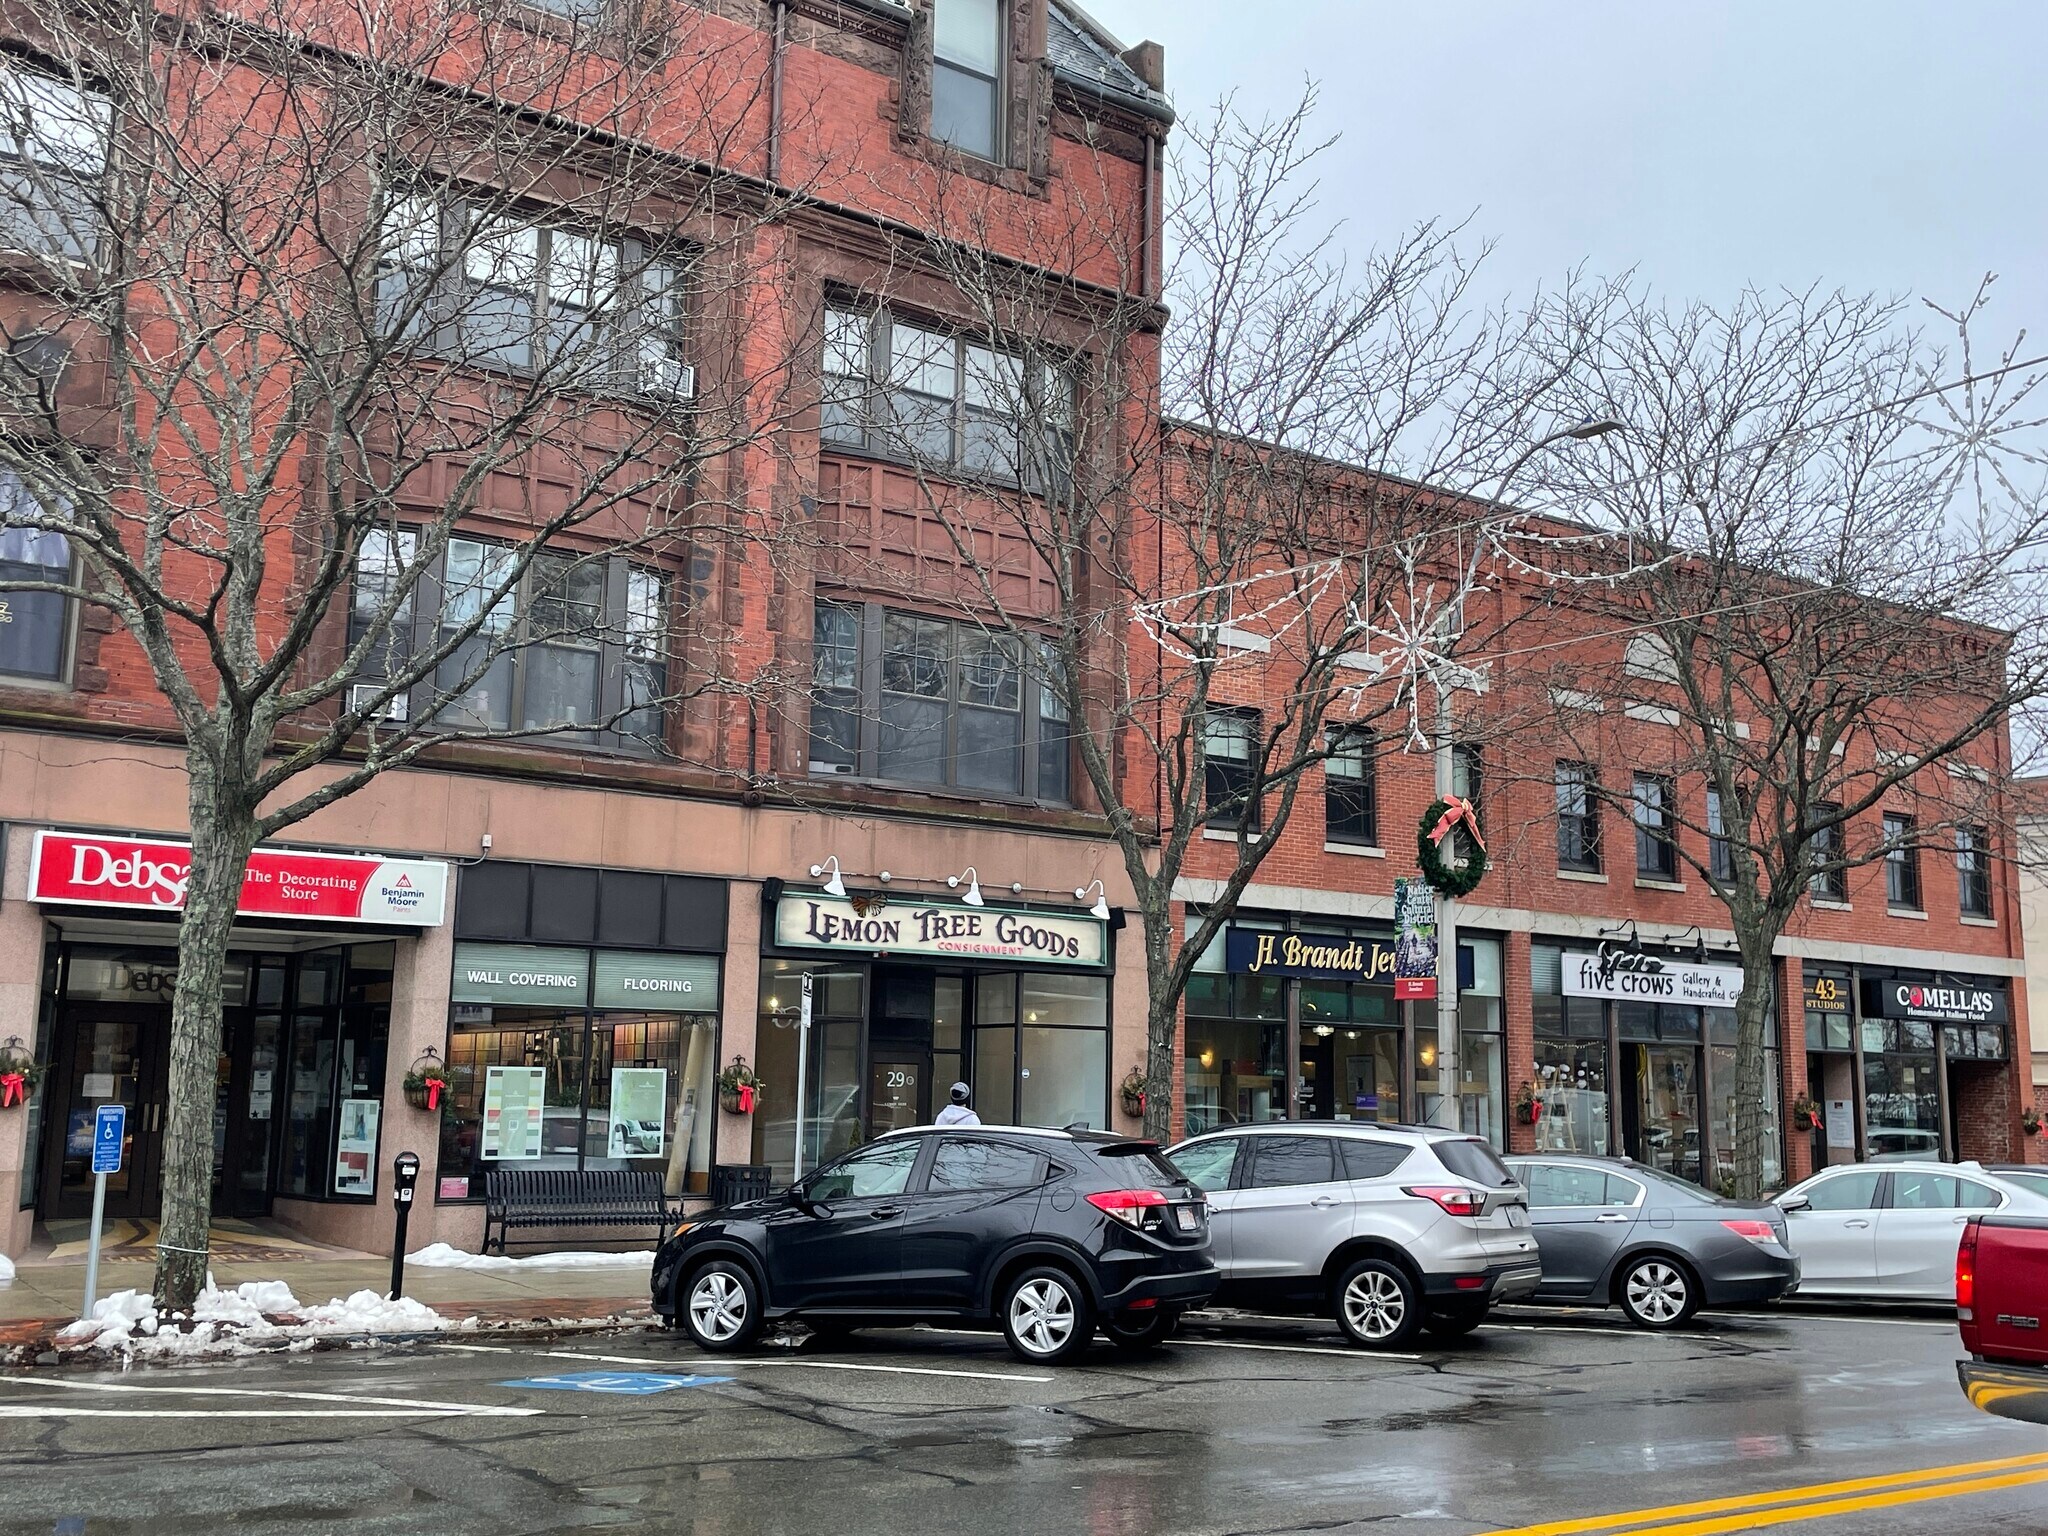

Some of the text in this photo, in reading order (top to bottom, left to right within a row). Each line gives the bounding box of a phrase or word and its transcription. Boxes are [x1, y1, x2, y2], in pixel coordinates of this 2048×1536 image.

[245, 869, 357, 891] The Decorating
[281, 886, 319, 900] Store
[382, 887, 425, 900] Benjamin
[387, 896, 418, 907] Moore
[1401, 904, 1434, 916] Cultural
[1404, 914, 1434, 925] District
[805, 901, 1079, 958] LEMON TREE GOODS
[937, 941, 1024, 955] CONSIGNMENT
[1249, 934, 1278, 972] H.
[1282, 935, 1362, 971] Brandt
[467, 970, 577, 988] WALL COVERING
[1580, 959, 1673, 996] five crows
[1682, 973, 1722, 988] Gallery &
[624, 978, 692, 993] FLOORING
[1814, 977, 1837, 1000] 43
[1683, 988, 1725, 1000] Handcrafted
[1806, 999, 1845, 1010] STUDIOS
[1907, 1007, 1986, 1021] Homemade Italian Food
[886, 1071, 905, 1087] 29
